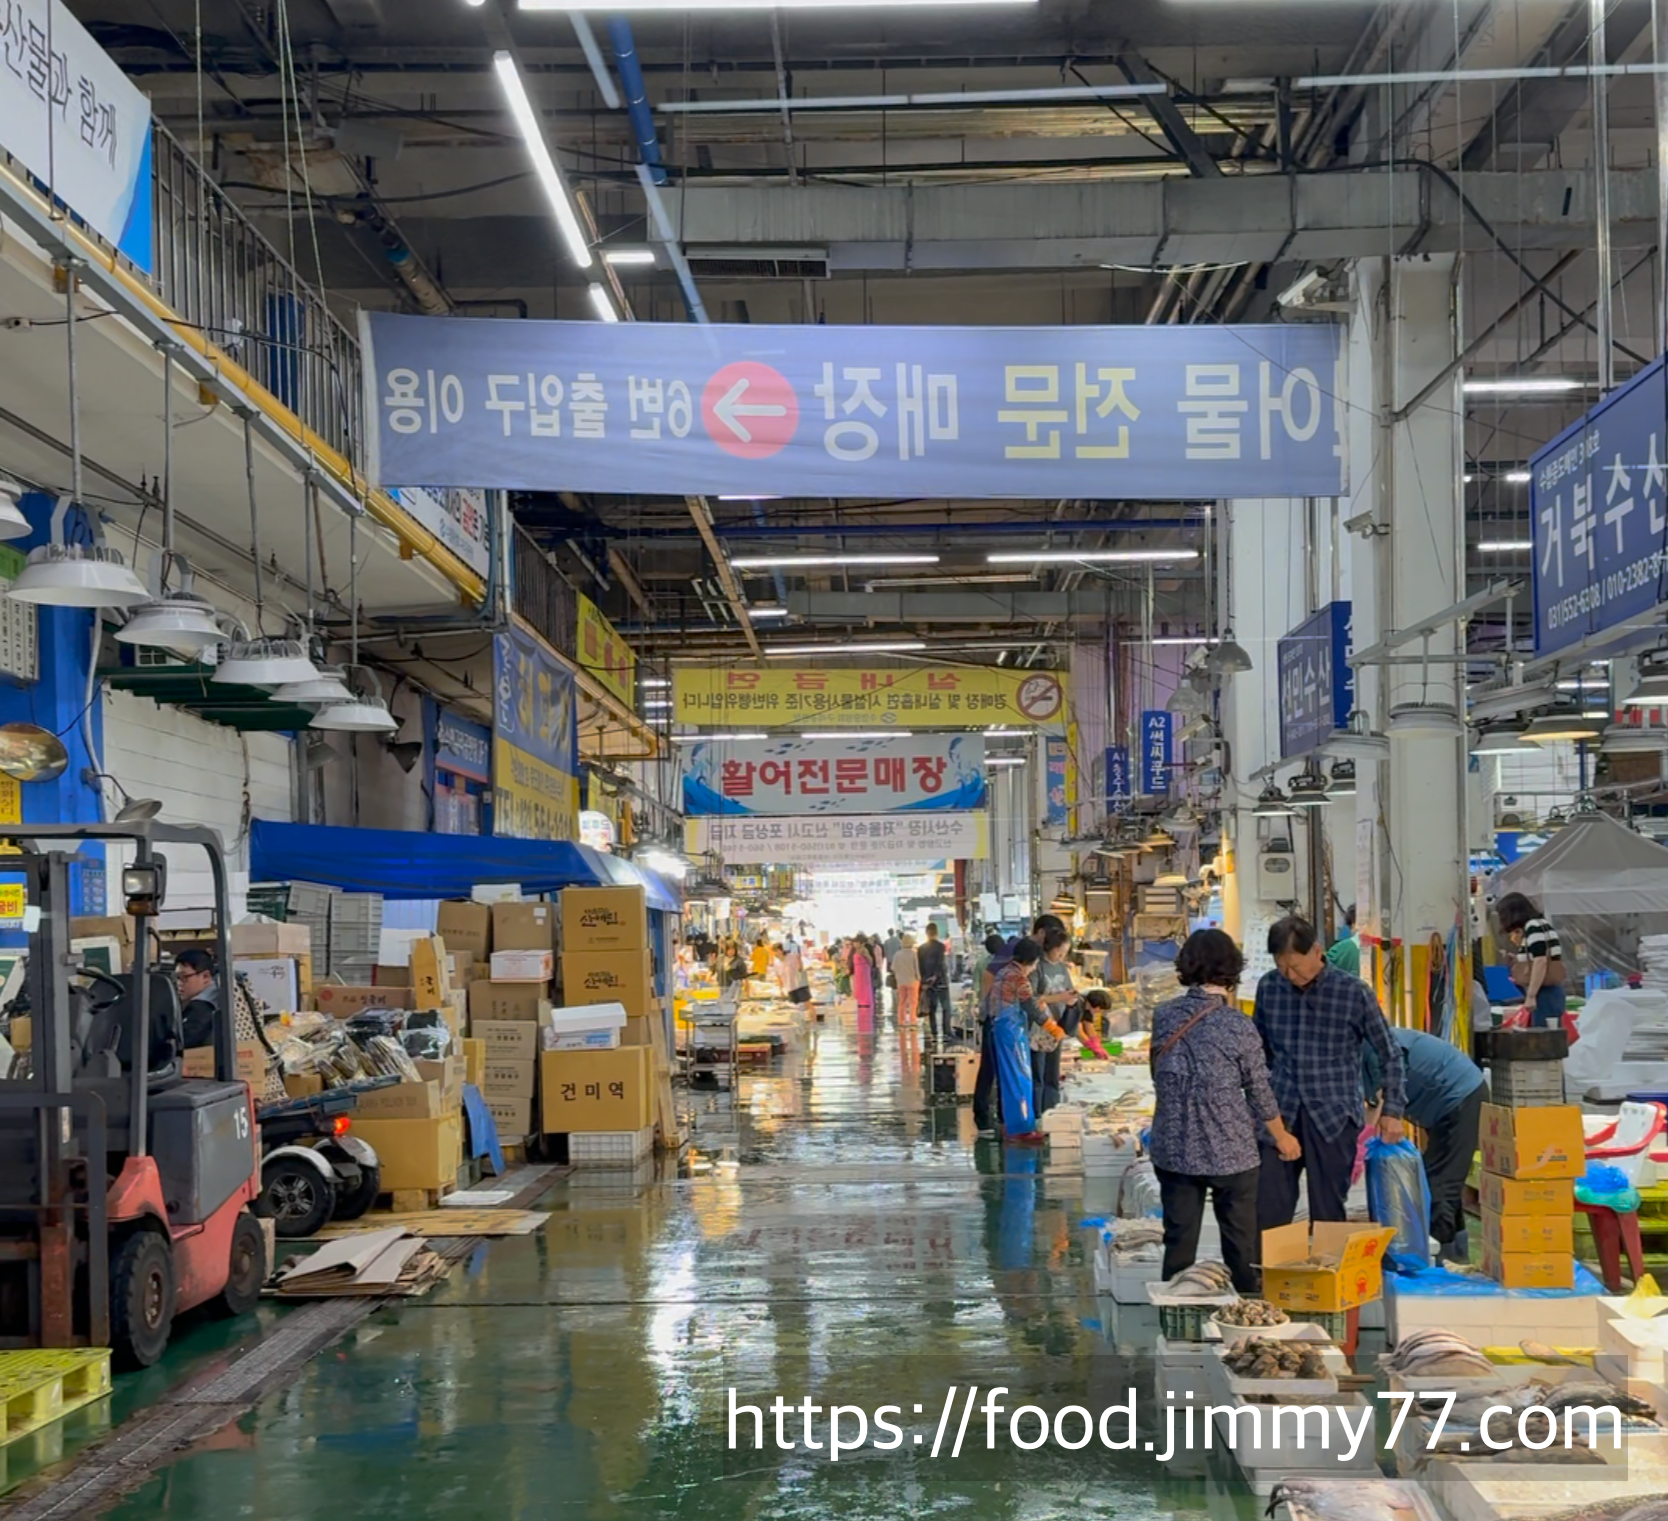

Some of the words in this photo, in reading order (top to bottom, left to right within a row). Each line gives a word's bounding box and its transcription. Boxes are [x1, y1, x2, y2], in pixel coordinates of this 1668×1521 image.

[0, 0, 72, 122] 산물과
[78, 75, 117, 170] 함께
[1541, 432, 1667, 588] 거북수산
[1148, 717, 1166, 728] A2
[721, 756, 947, 797] 활어전문매장
[560, 1081, 625, 1101] 건미역
[233, 1106, 249, 1140] 15
